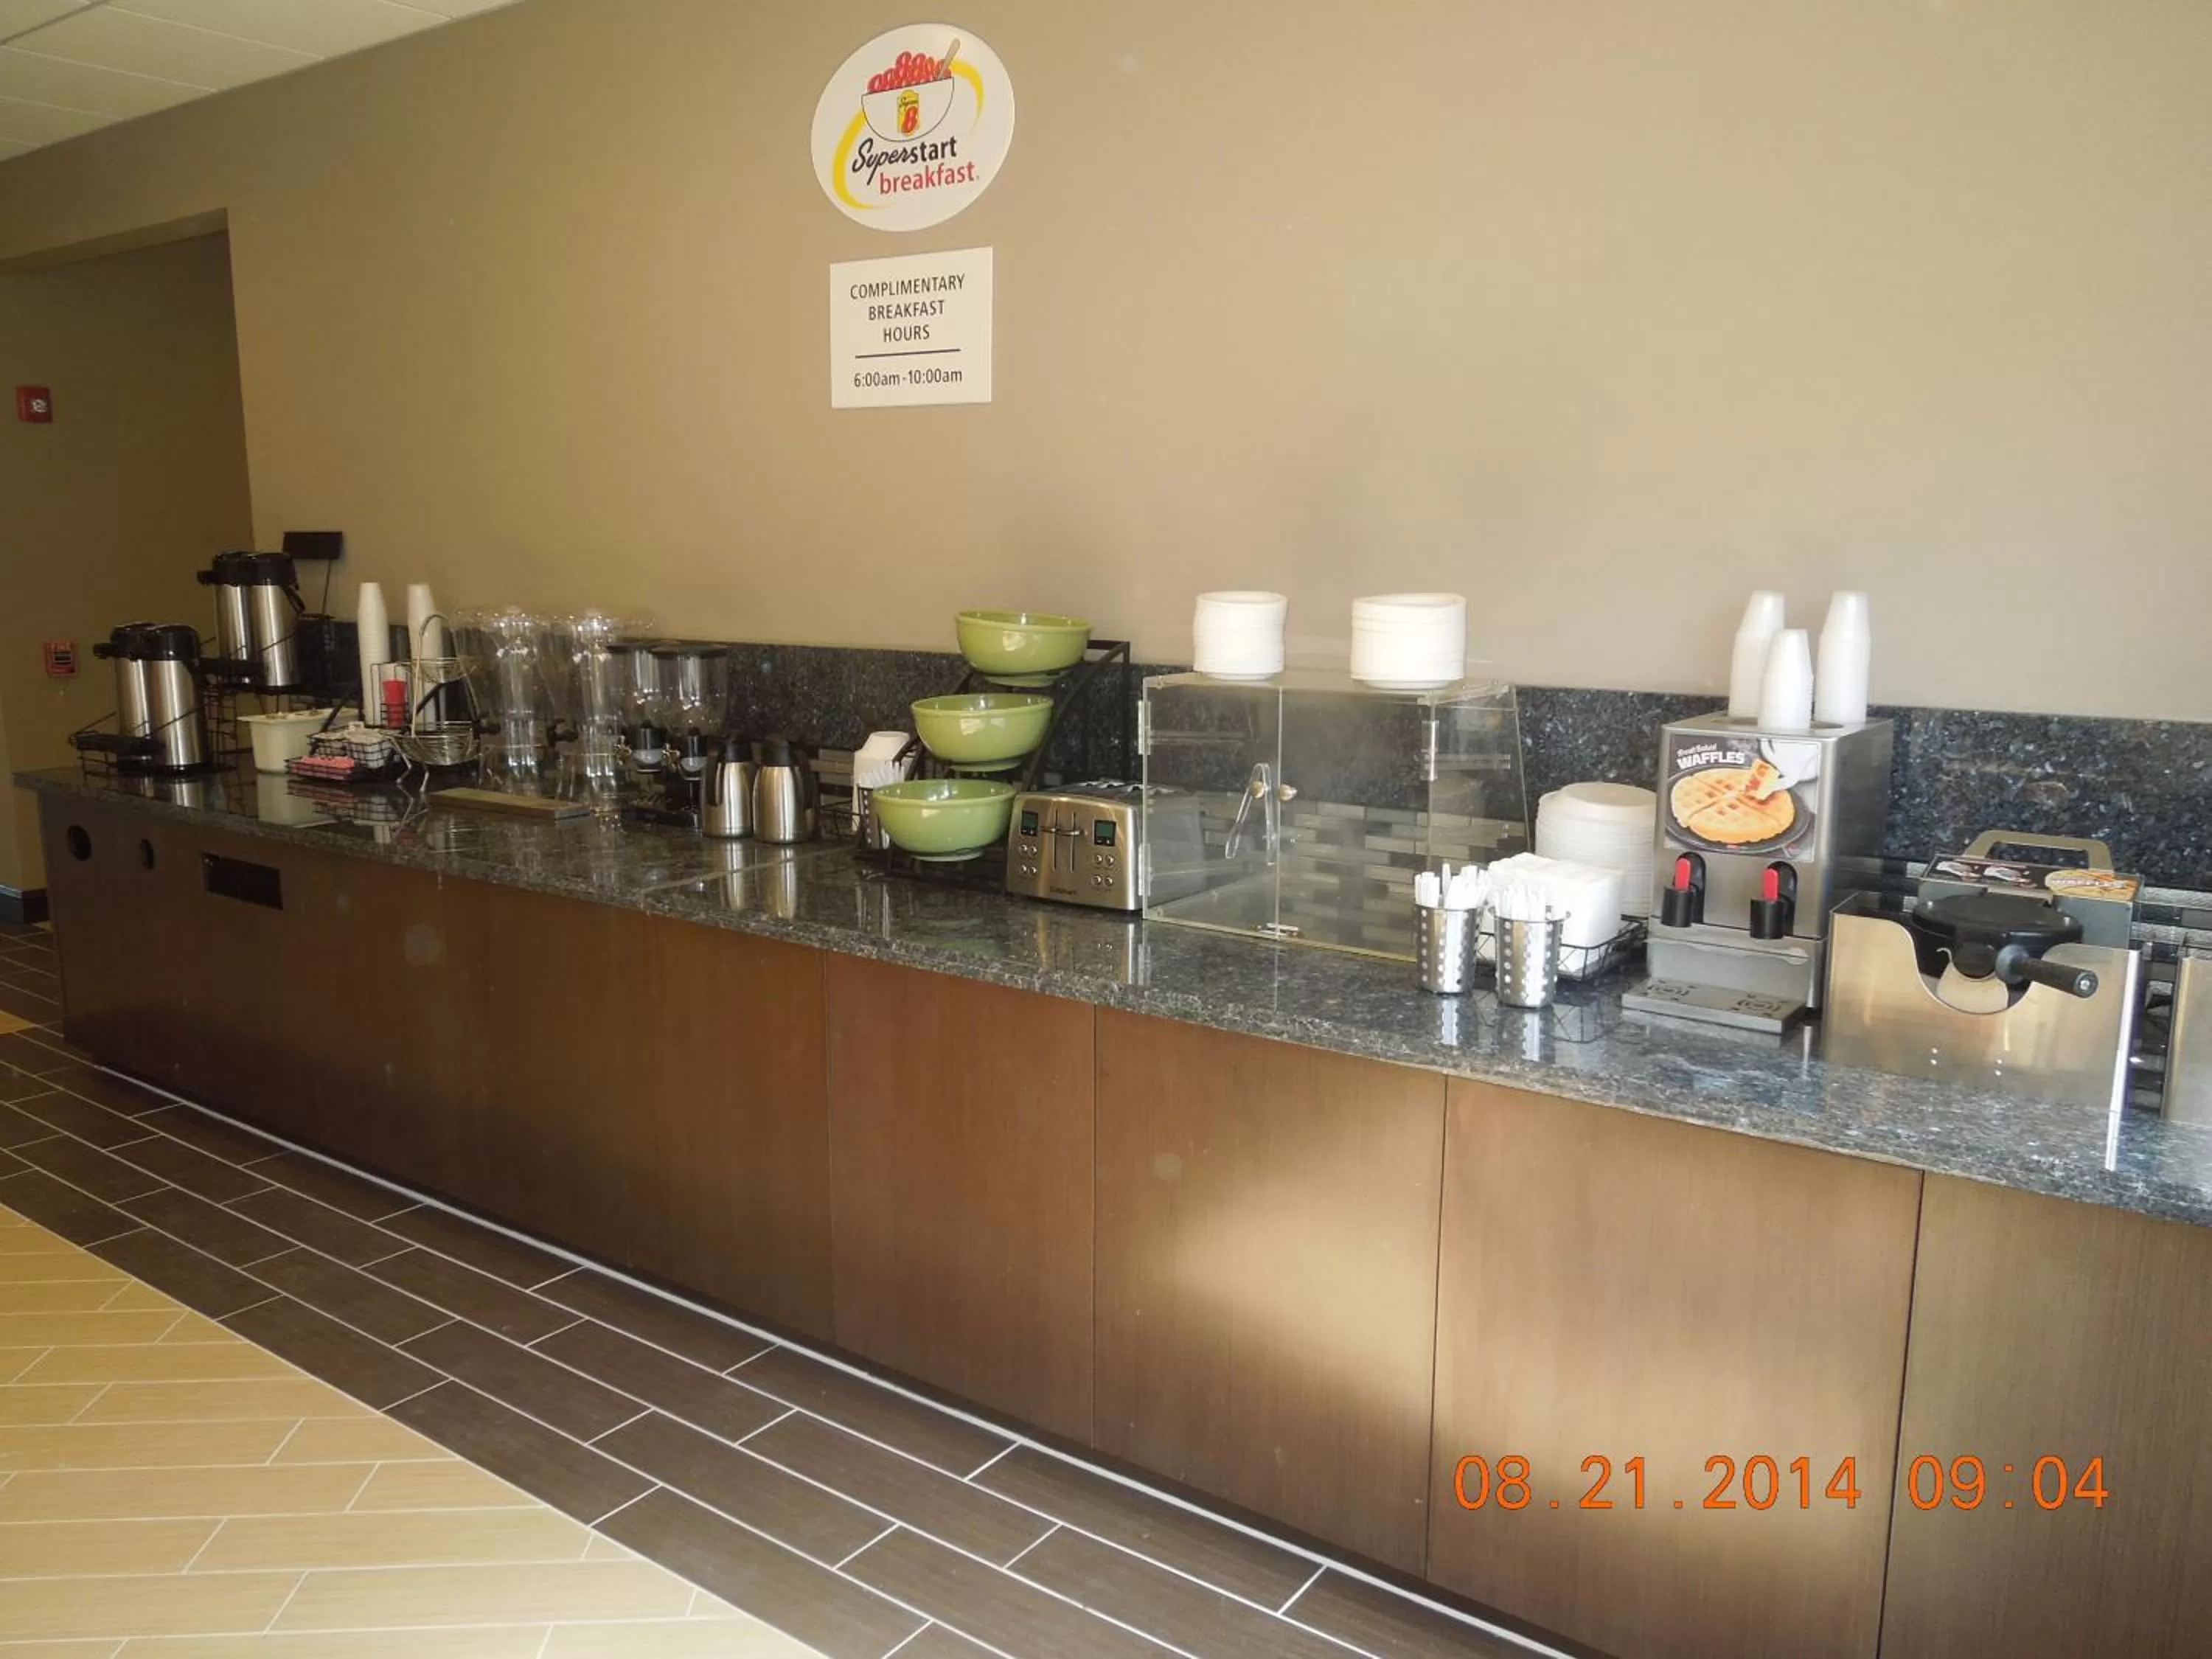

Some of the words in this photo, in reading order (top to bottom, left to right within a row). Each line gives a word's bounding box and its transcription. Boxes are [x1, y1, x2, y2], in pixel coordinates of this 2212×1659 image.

[852, 135, 957, 185] Superstart
[880, 161, 975, 195] breakfast
[850, 274, 965, 299] COMPLIMENTARY
[869, 299, 945, 321] BREAKFAST
[883, 324, 930, 342] HOURS
[1677, 751, 1745, 770] WAFFLES
